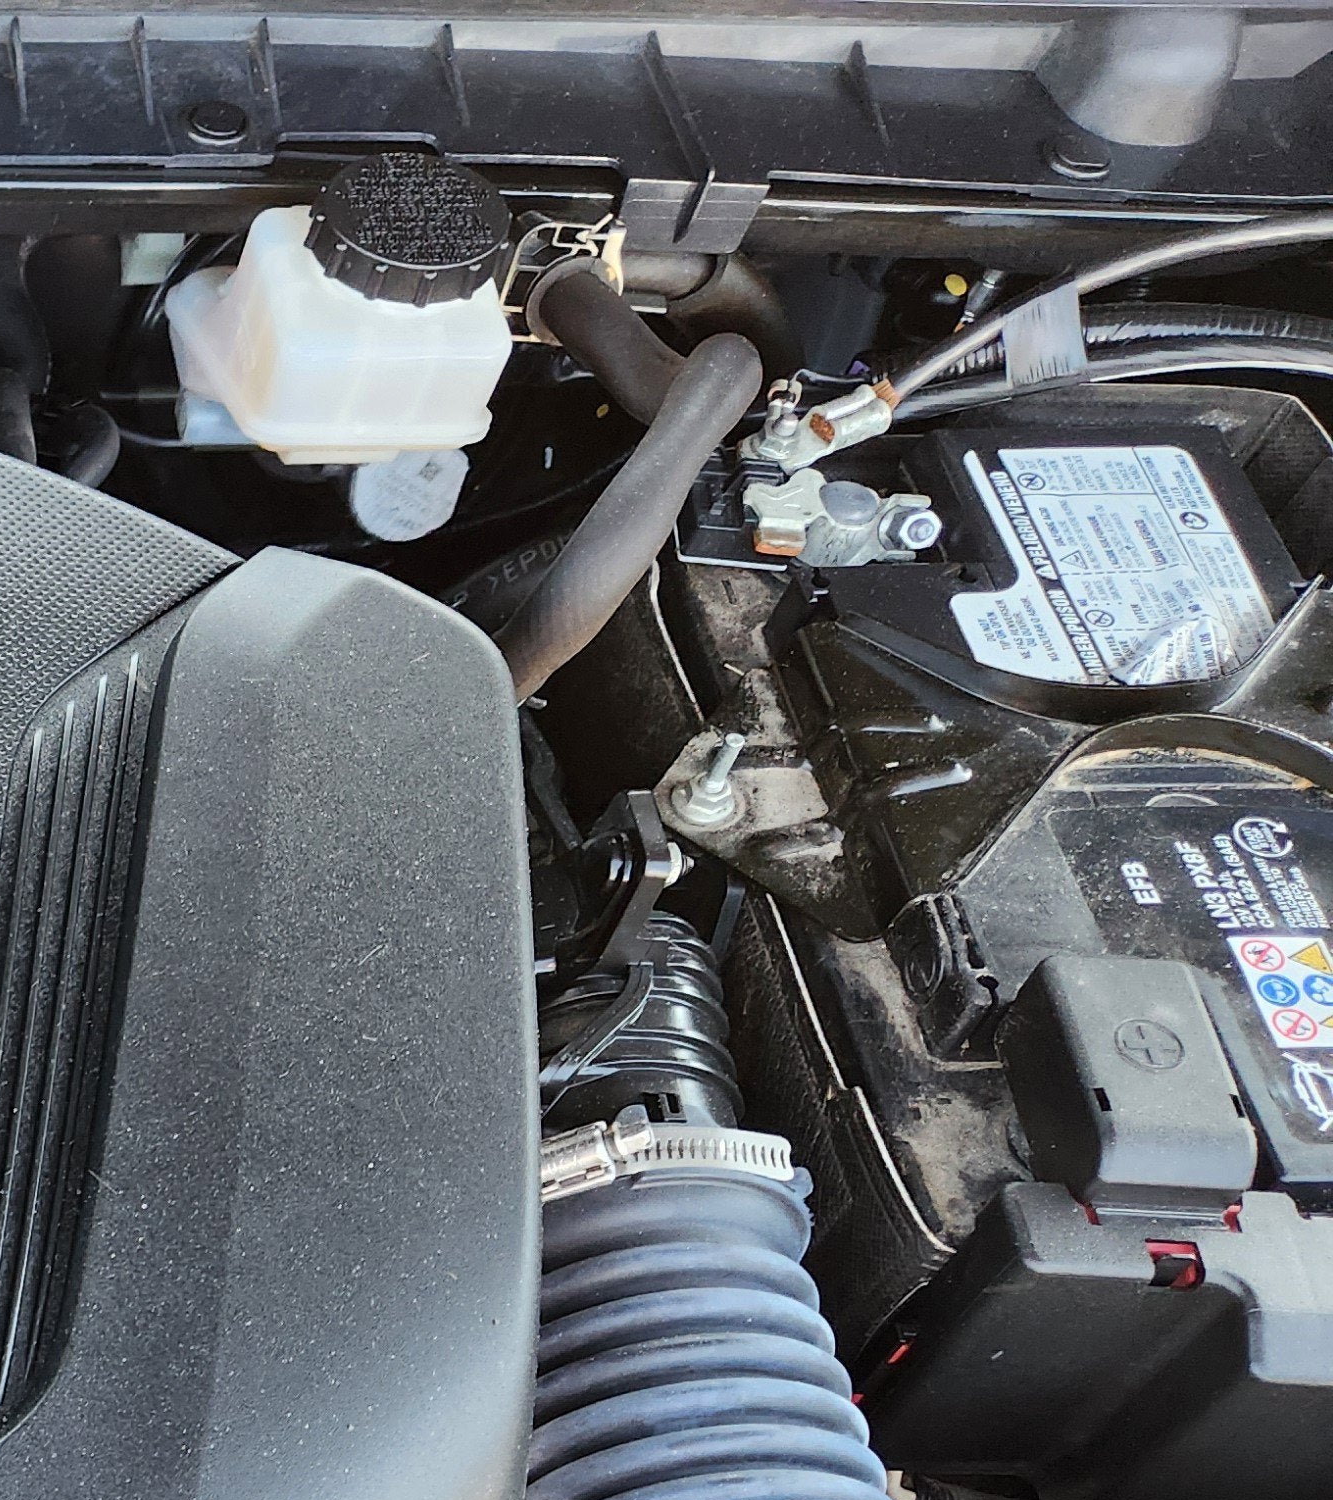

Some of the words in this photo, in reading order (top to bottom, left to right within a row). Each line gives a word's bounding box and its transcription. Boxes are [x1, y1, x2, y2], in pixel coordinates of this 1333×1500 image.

[1175, 840, 1219, 889] PX8F
[1213, 834, 1244, 867] (SAE)
[1121, 861, 1163, 905] EFB
[1218, 870, 1237, 889] Ah
[1203, 891, 1241, 929] LN3
[1235, 909, 1257, 928] 12V
[1250, 902, 1275, 928] CCA
